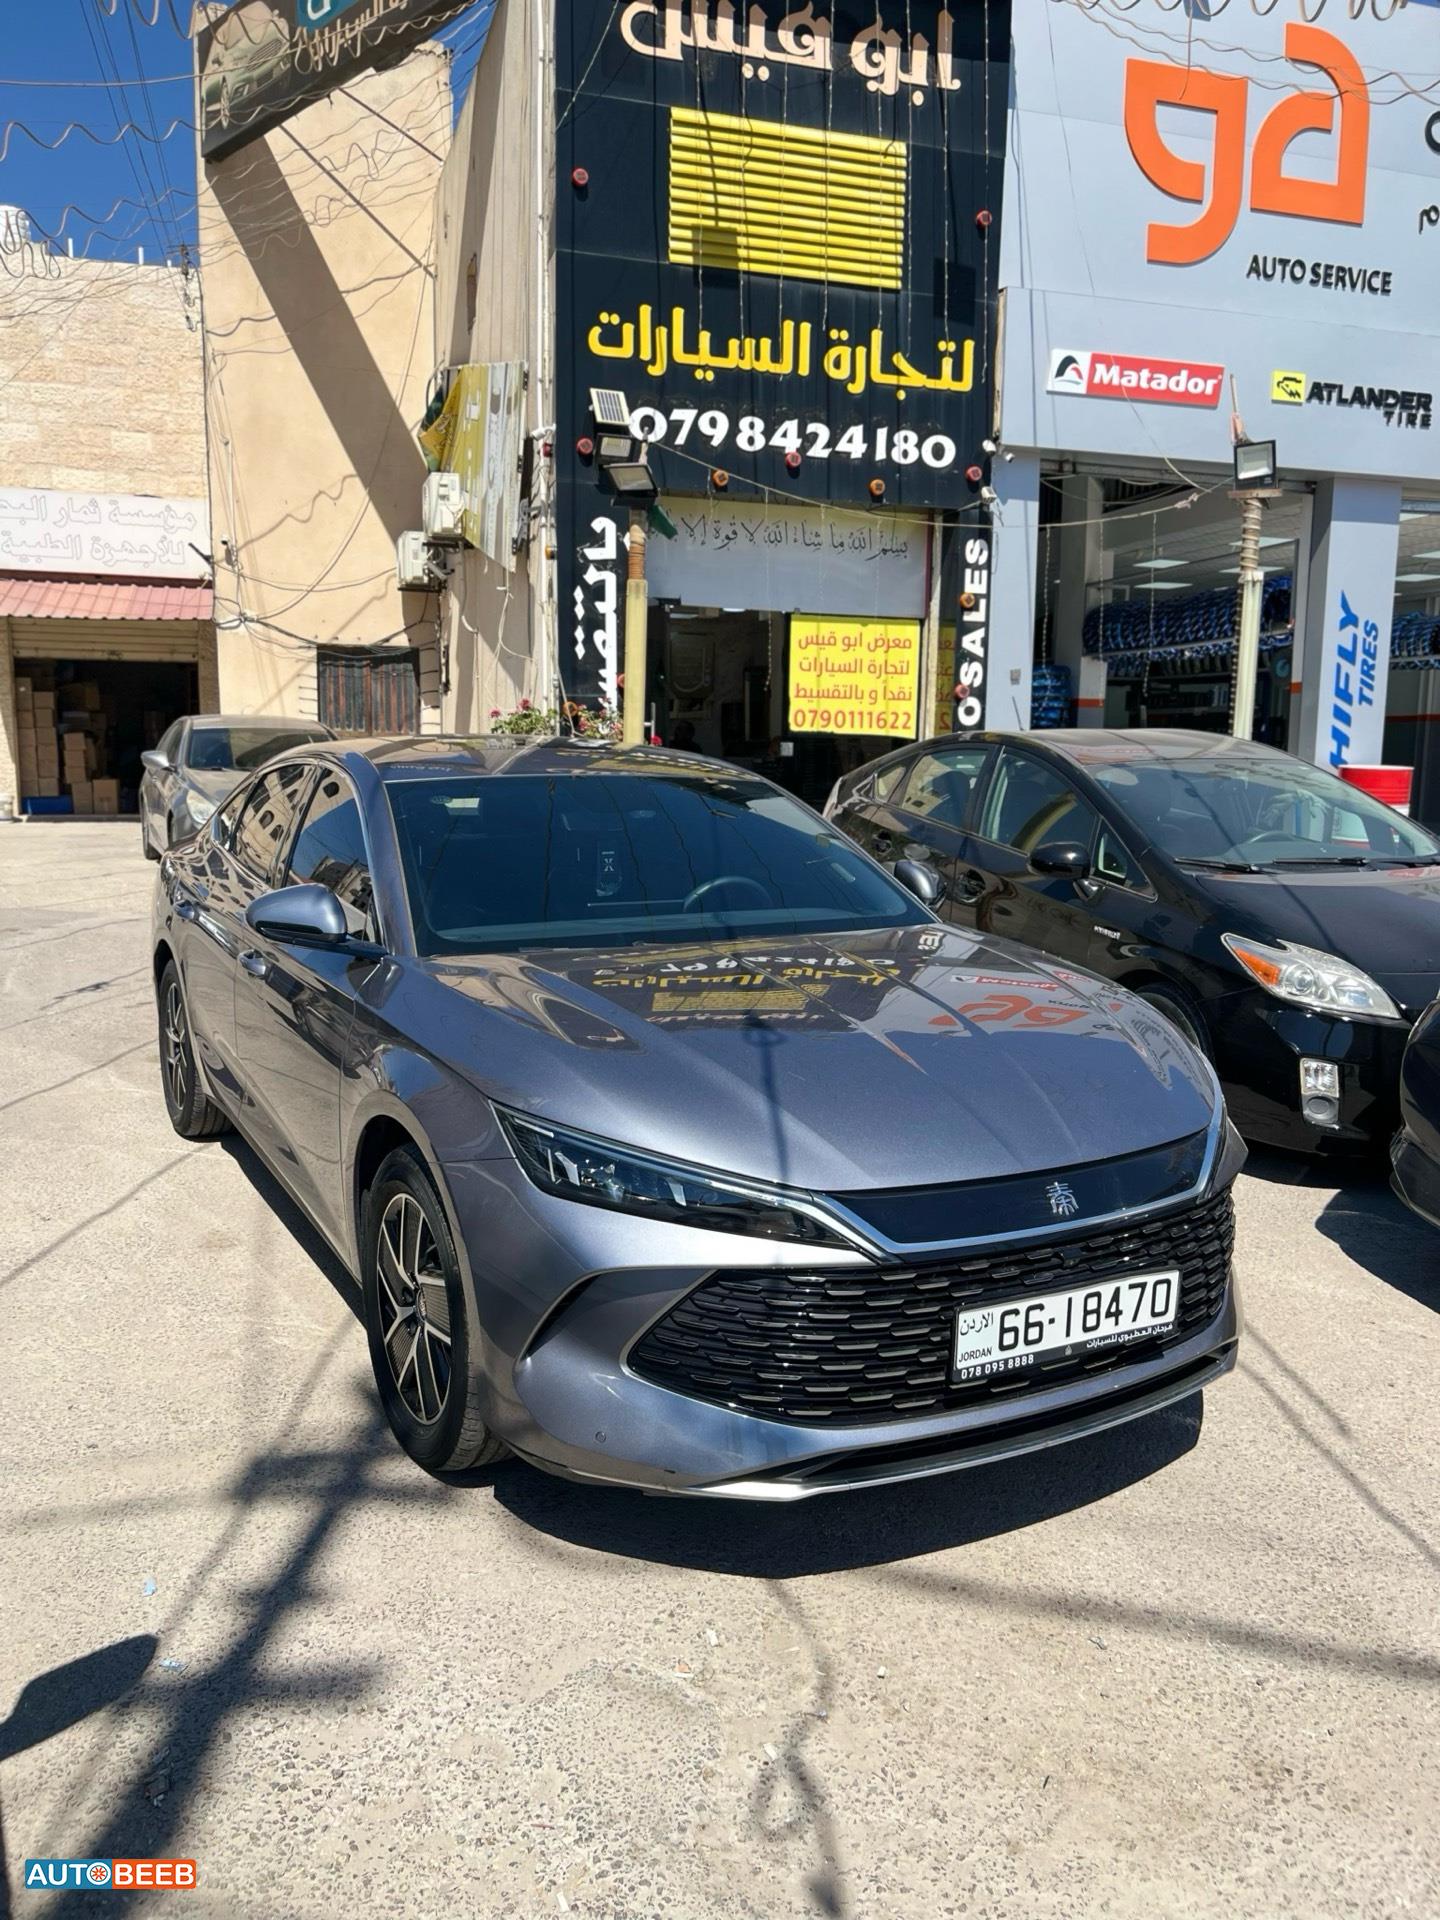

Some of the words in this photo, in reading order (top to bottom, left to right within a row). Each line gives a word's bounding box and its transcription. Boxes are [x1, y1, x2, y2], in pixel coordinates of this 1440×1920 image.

[1246, 254, 1307, 285] AUTO
[1309, 261, 1393, 296] SERVICE
[587, 304, 811, 381] السيارات
[823, 328, 976, 400] لتجارة
[1093, 361, 1220, 396] Matador
[1306, 381, 1433, 413] ATLANDER
[1383, 410, 1433, 430] TIRE
[628, 406, 956, 469] 0798424180
[108, 499, 198, 535] مؤسسة
[1, 532, 82, 564] الطبية
[959, 538, 989, 688] SALES
[798, 632, 837, 650] قيس
[842, 632, 863, 652] ابو
[867, 633, 912, 652] معرض
[799, 656, 863, 678] السيارات
[867, 658, 910, 680] لتجارة
[1358, 618, 1380, 707] TIRES
[794, 683, 865, 704] بالتقسيط
[1330, 589, 1360, 769] HIFLY
[794, 709, 912, 730] 0790111622
[998, 1278, 1172, 1352] 66-18470
[959, 1346, 993, 1363] JORDAN
[961, 1366, 982, 1380] 078
[984, 1360, 1005, 1374] 095
[1007, 1354, 1034, 1369] 8888
